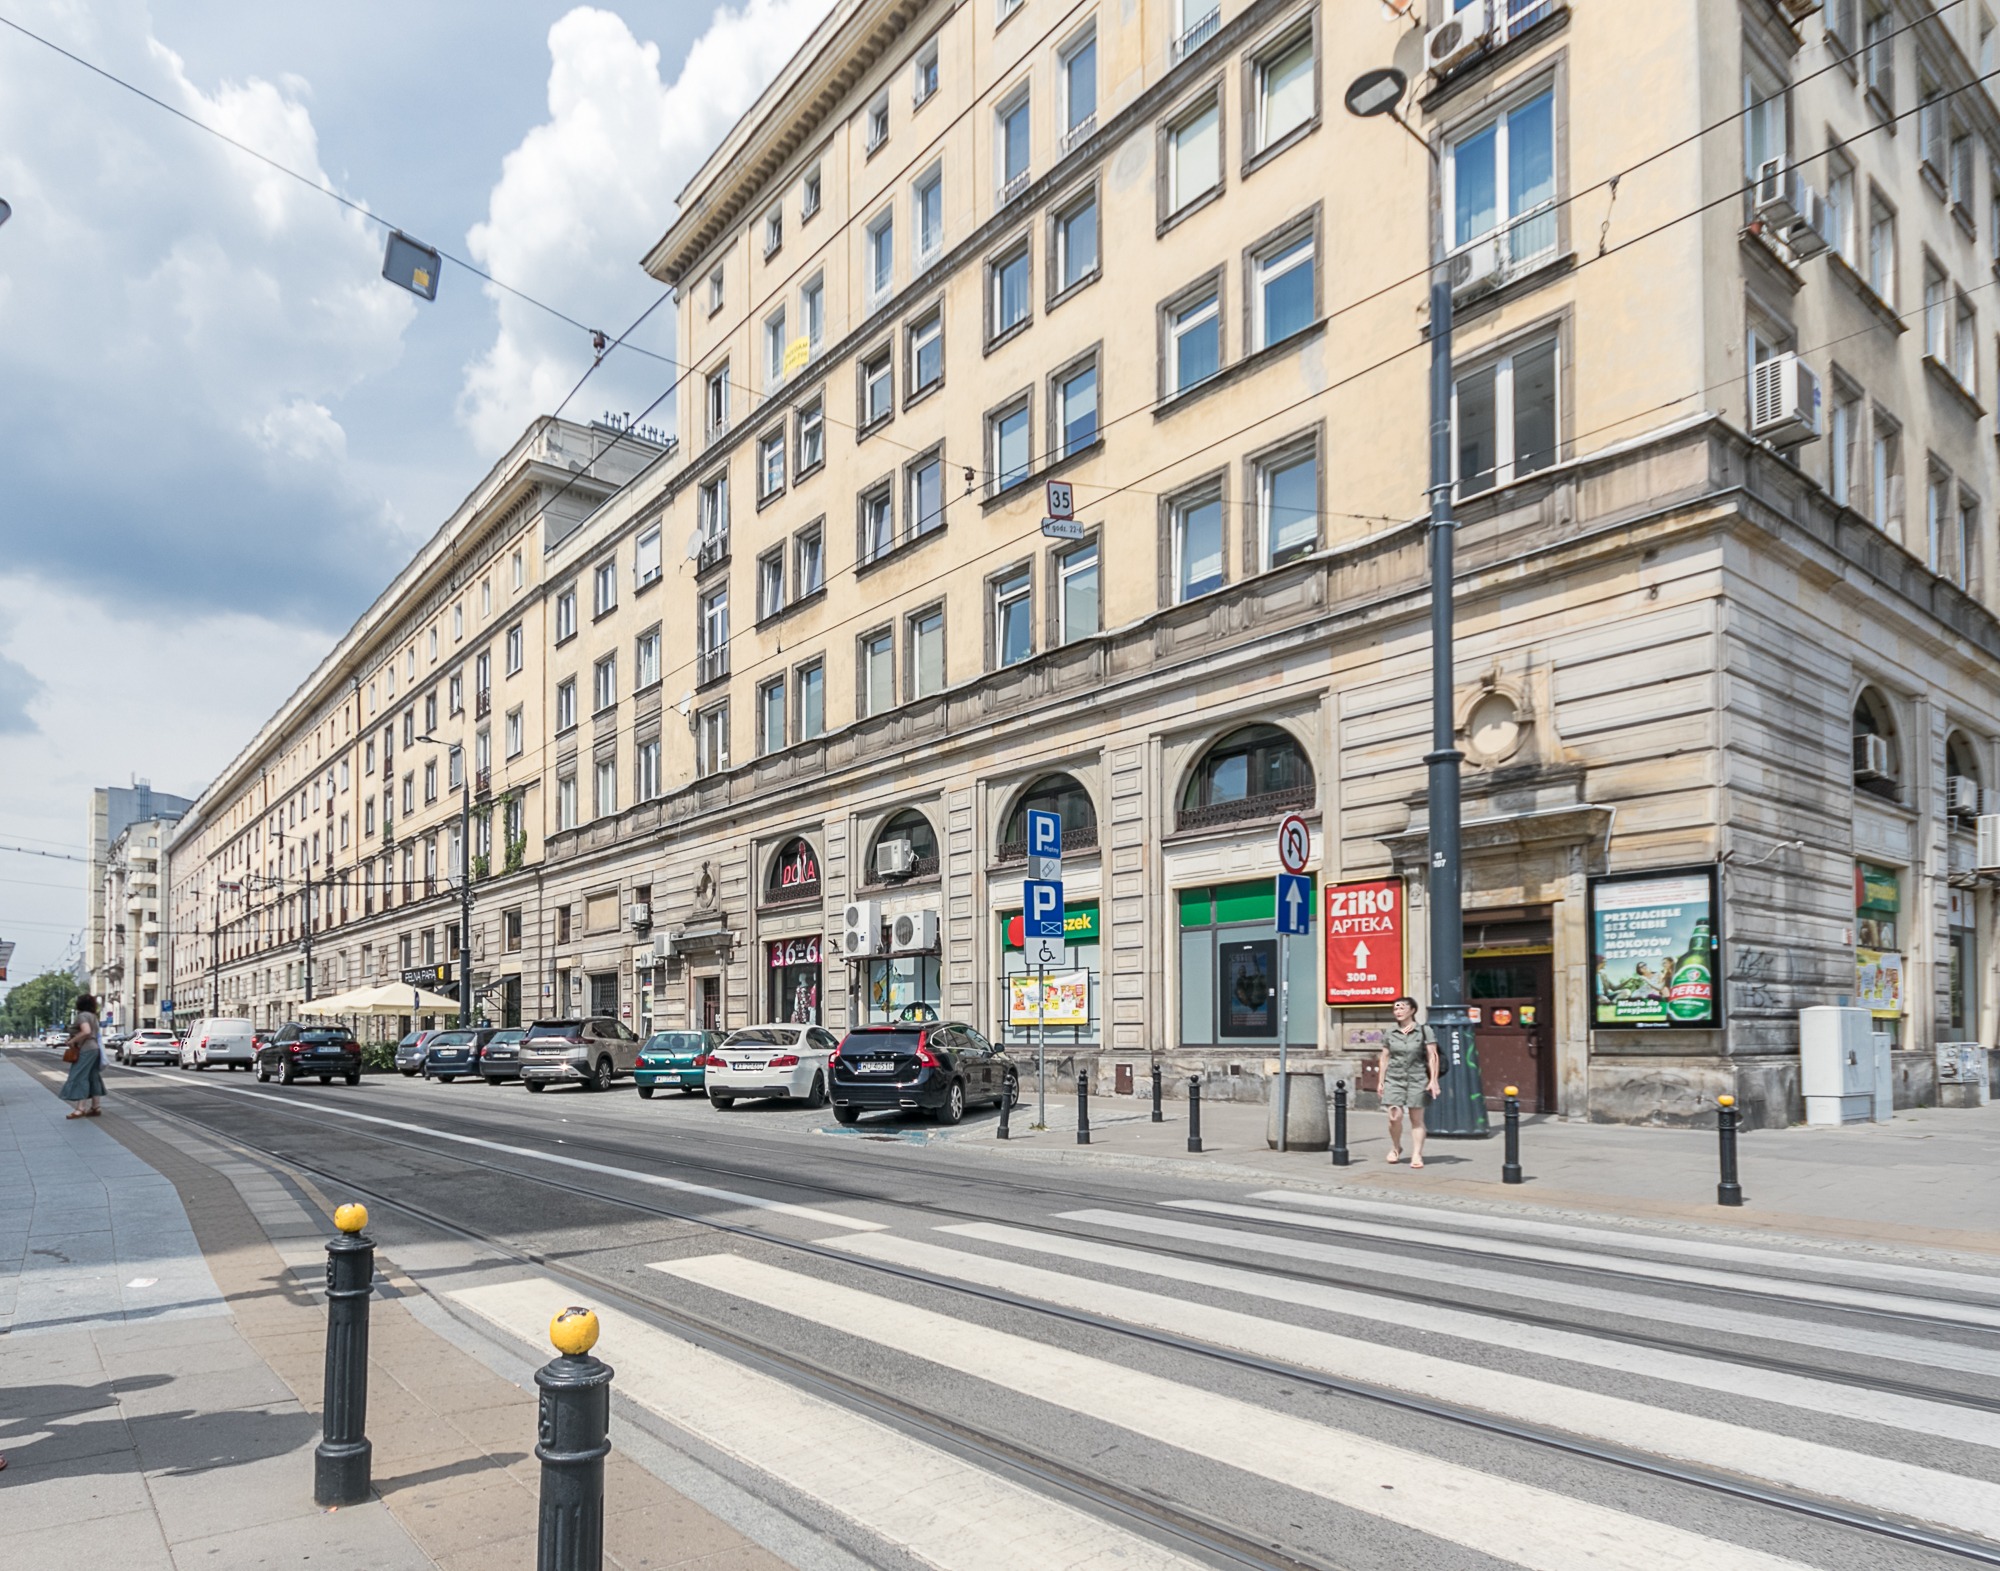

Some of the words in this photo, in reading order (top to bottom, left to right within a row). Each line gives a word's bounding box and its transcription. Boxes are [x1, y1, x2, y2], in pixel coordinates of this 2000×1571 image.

[1053, 491, 1070, 508] 35
[1036, 816, 1055, 851] P
[1033, 885, 1056, 921] P
[1604, 909, 1681, 921] PRZYJACIELE
[1331, 916, 1394, 934] APTEKA
[1604, 922, 1628, 932] BEZ
[1629, 919, 1668, 930] CIEBIE
[1604, 932, 1617, 940] TO
[1618, 931, 1636, 939] JAK
[1606, 937, 1671, 949] MOKOTÓW
[1605, 951, 1628, 959] BEZ
[1629, 948, 1663, 958] POLA
[1346, 972, 1367, 983] 300
[1672, 986, 1711, 996] PERŁA
